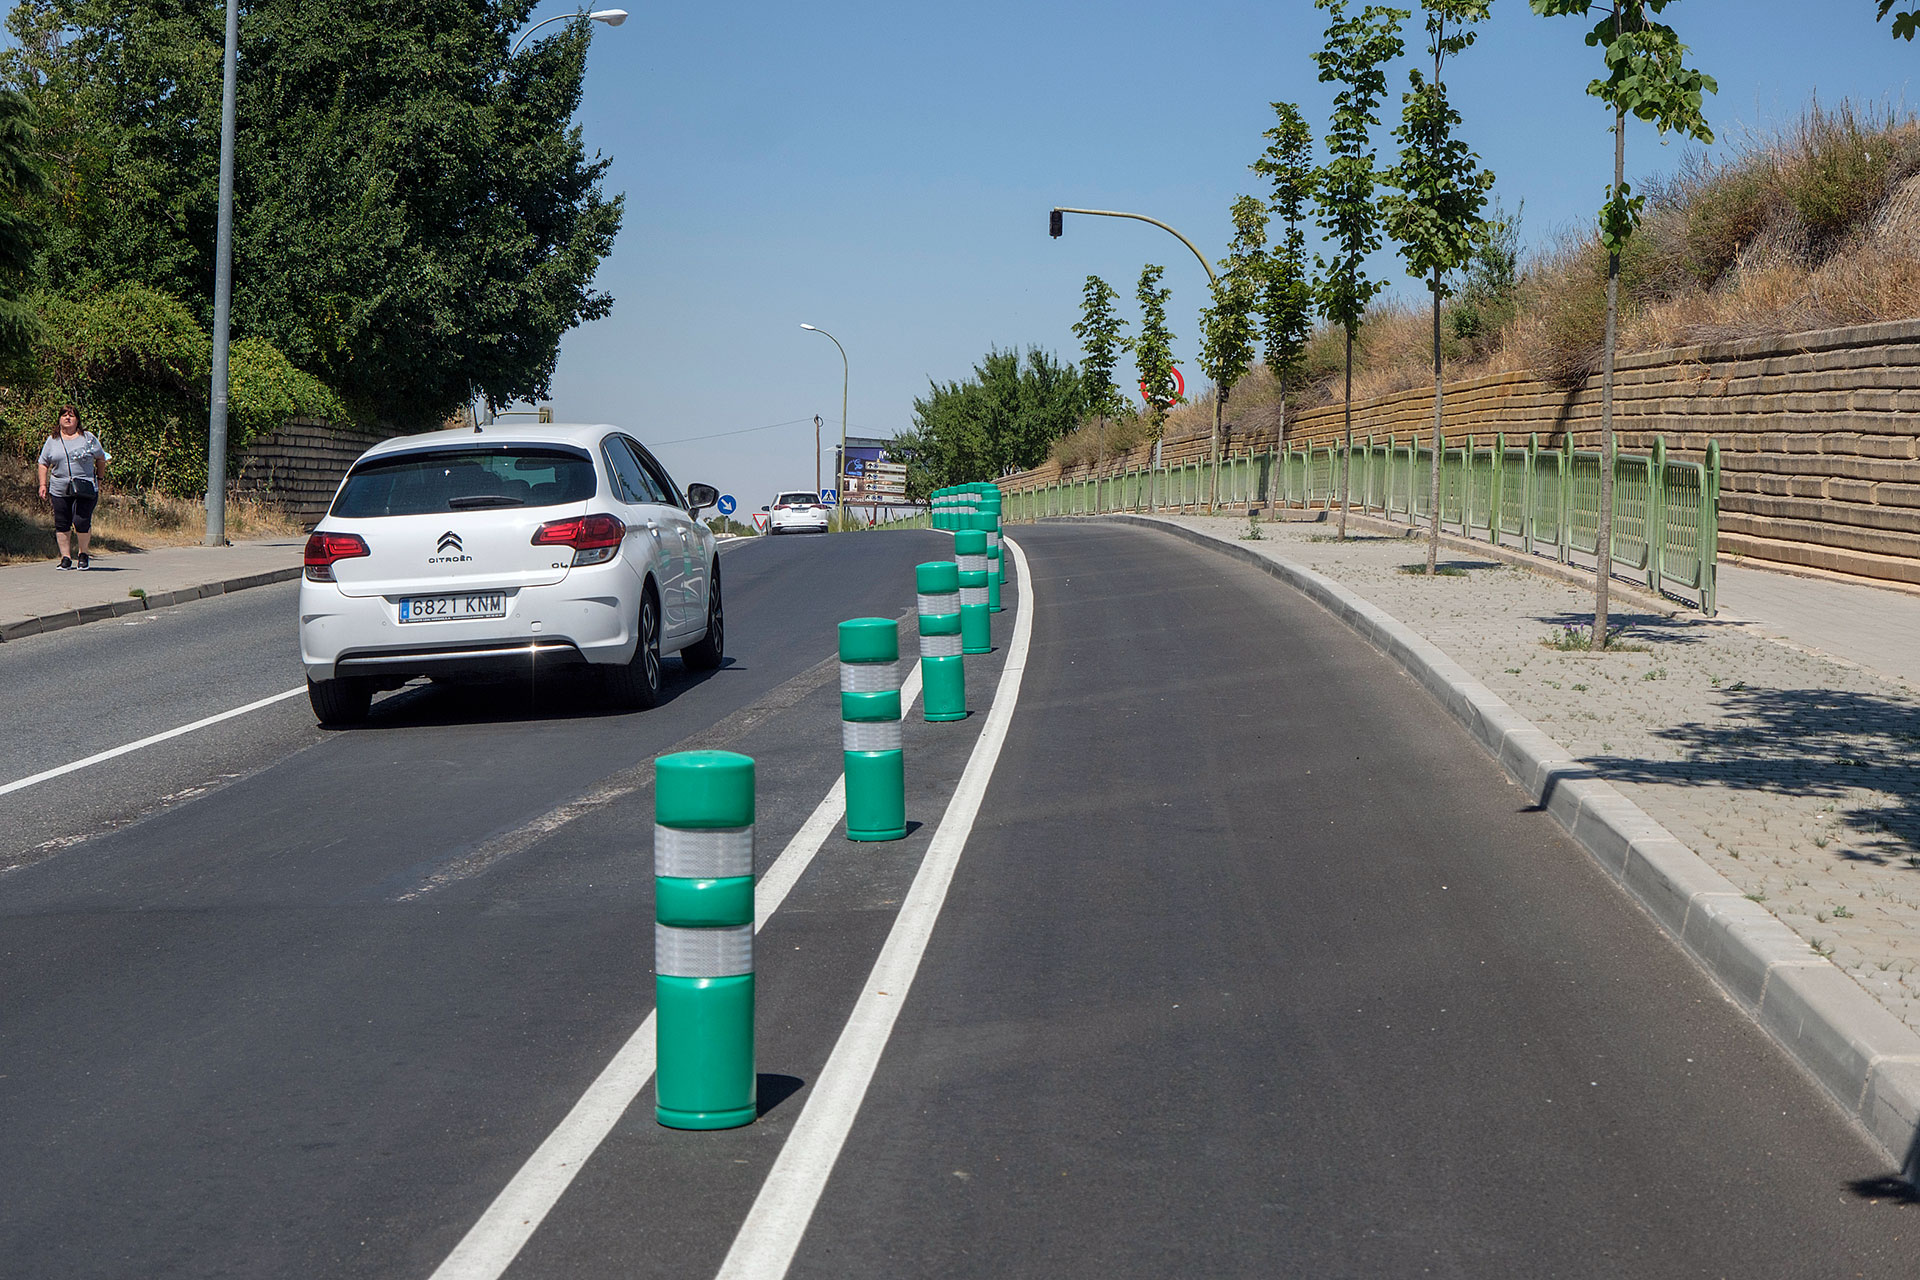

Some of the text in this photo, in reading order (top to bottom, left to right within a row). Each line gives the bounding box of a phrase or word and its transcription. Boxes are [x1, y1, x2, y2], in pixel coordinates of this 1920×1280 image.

[428, 555, 473, 564] CITROËN
[412, 595, 501, 616] 6821 KNM
